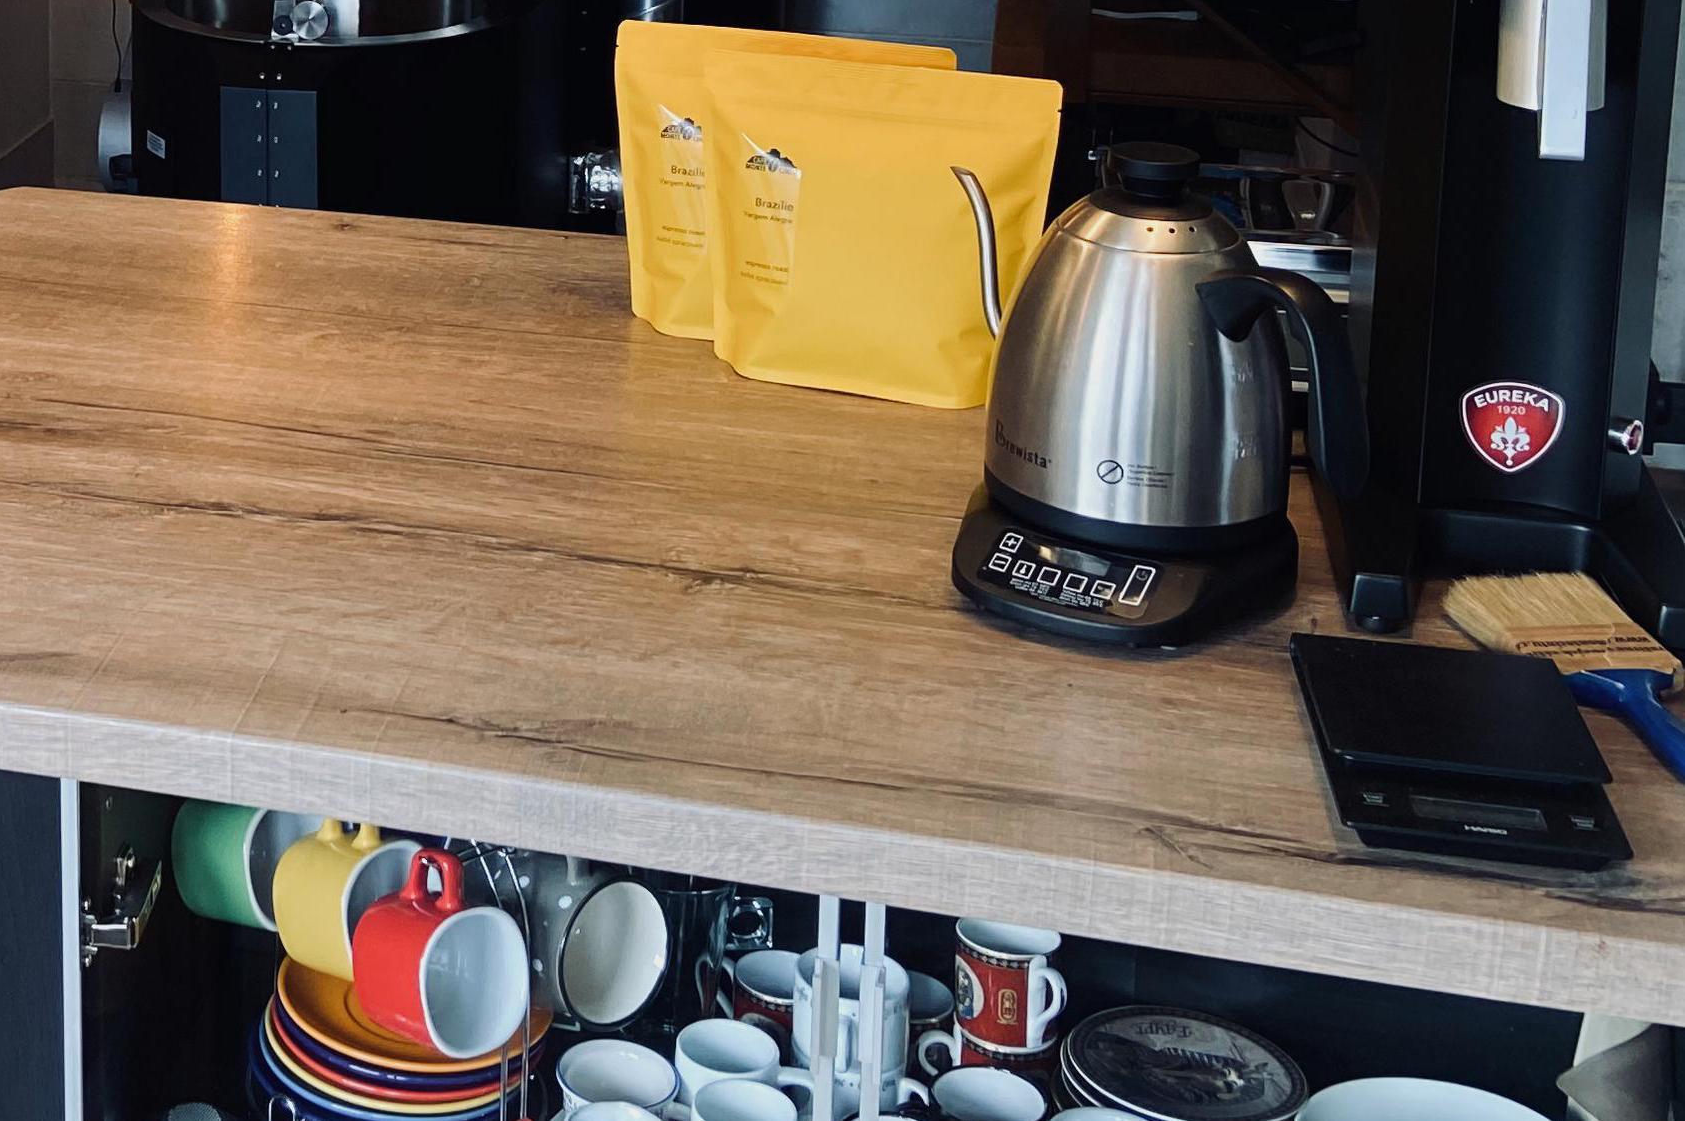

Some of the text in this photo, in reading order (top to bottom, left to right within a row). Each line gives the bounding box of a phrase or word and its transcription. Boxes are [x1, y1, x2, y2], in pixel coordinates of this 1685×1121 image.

[1474, 389, 1549, 412] EUREKA
[1497, 405, 1526, 415] 1920
[995, 419, 1048, 469] Brewista
